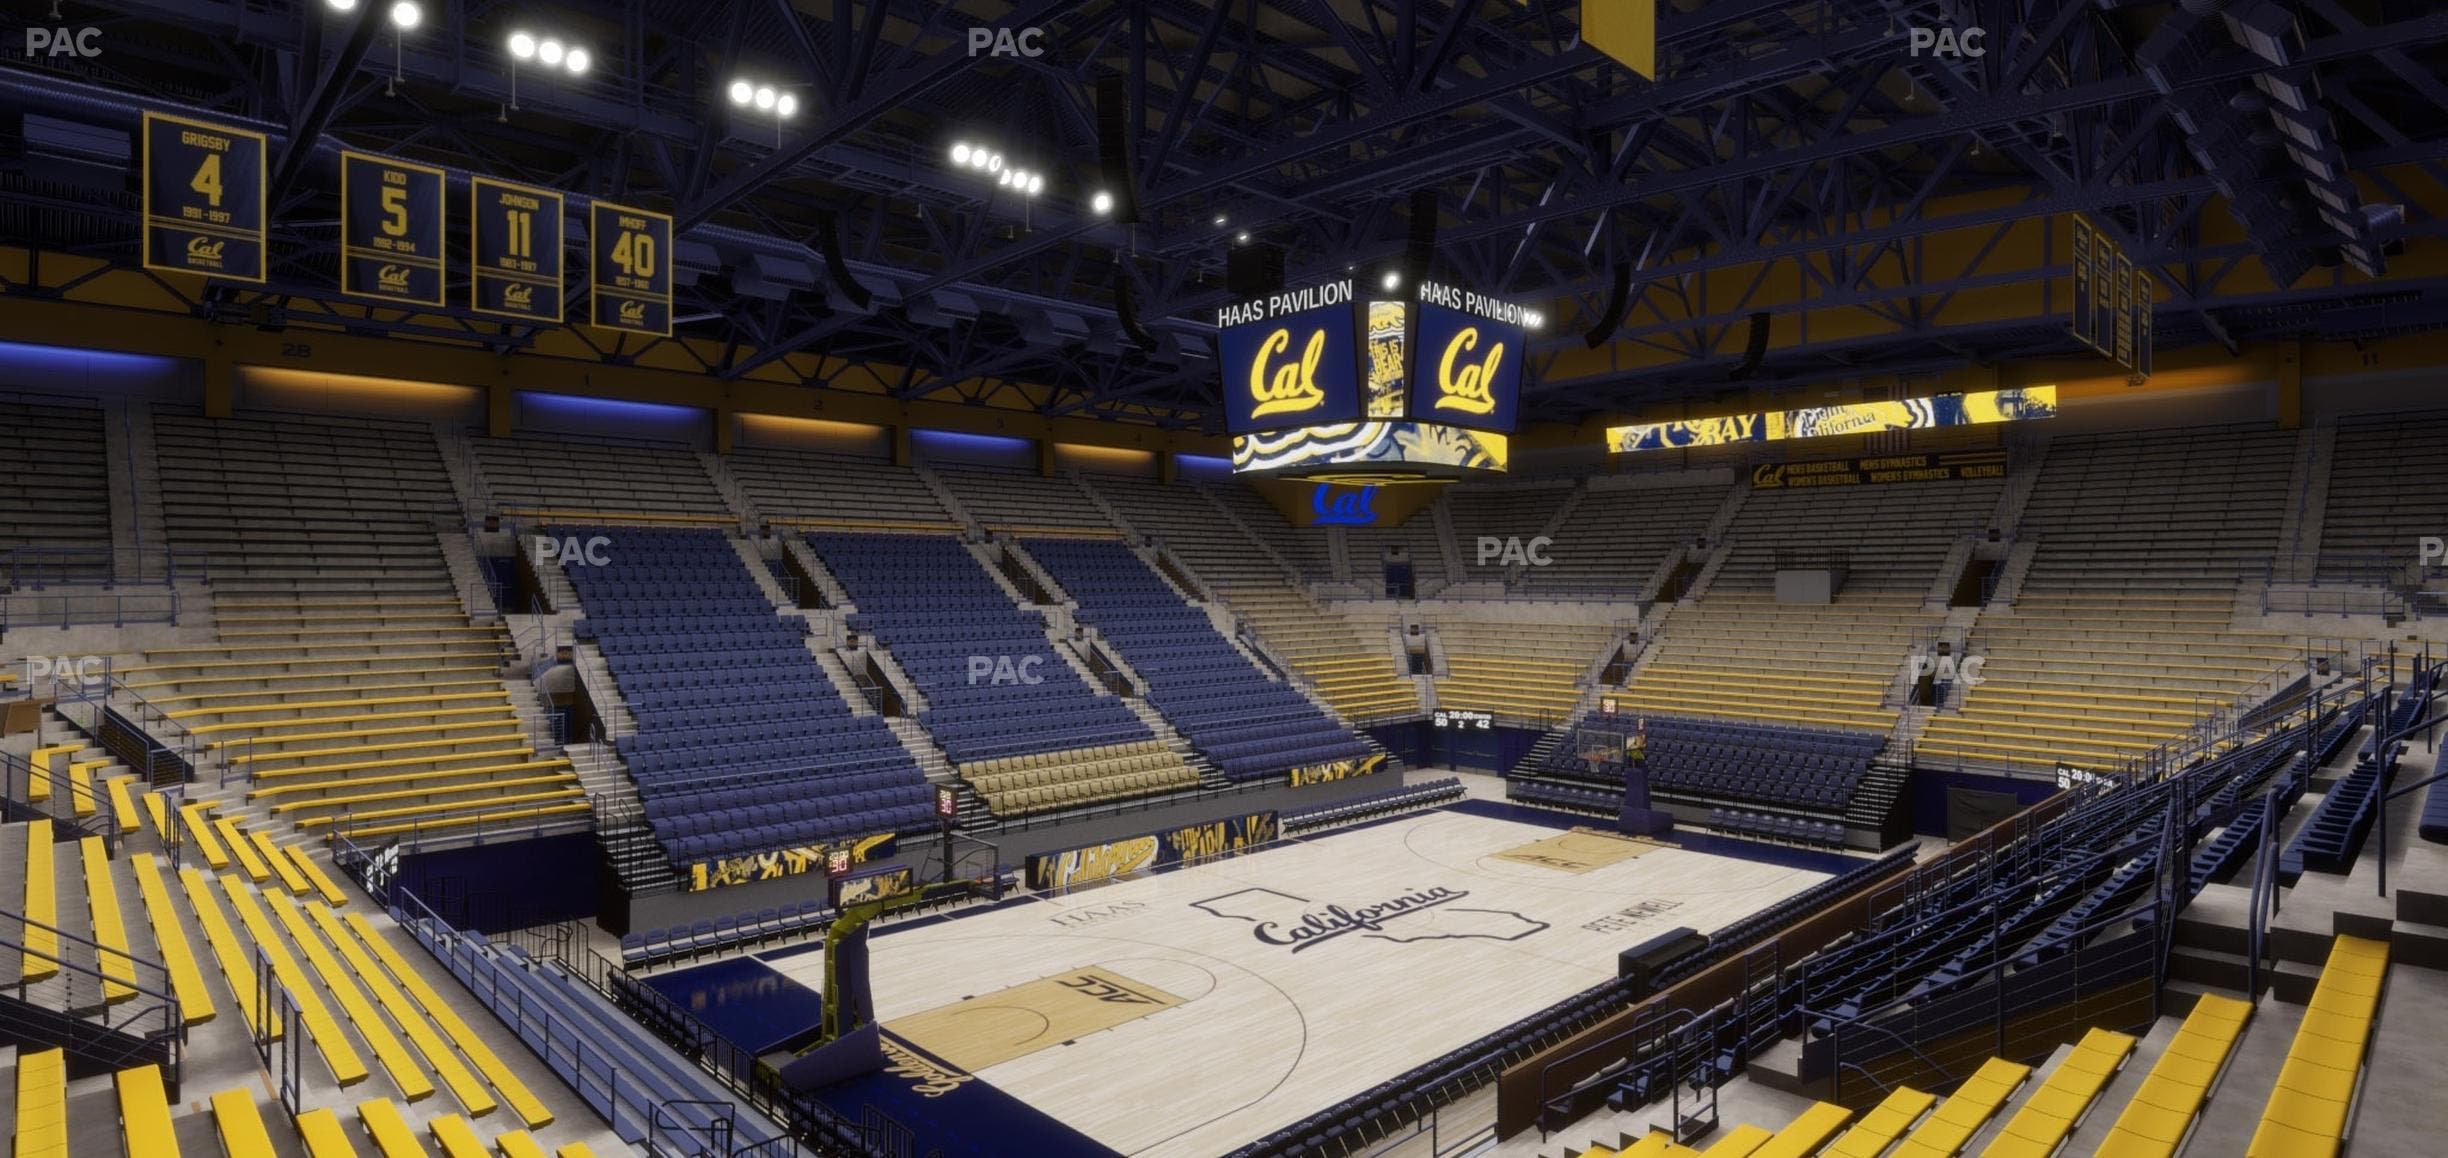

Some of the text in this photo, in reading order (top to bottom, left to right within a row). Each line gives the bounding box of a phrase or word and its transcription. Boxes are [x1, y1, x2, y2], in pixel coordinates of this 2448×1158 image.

[182, 131, 230, 151] GRIGSBY
[190, 154, 222, 206] 4
[382, 186, 407, 237] 5
[499, 193, 539, 210] JOHNSON
[507, 210, 530, 257] 11
[187, 236, 224, 260] Cal
[611, 231, 654, 278] 40
[379, 265, 410, 286] Cal
[504, 283, 532, 303] Cal
[1218, 279, 1353, 328] HAAS PAVILION
[1421, 281, 1527, 327] HAAS PAVILION
[620, 300, 646, 318] Cal
[1250, 328, 1325, 419] Cal
[1435, 327, 1504, 414] Cal
[1753, 464, 1785, 487] Cal
[1807, 460, 1849, 472] BASKETBALL
[1311, 483, 1379, 525] Cal
[1435, 718, 1490, 729] 50 2 42
[1449, 711, 1473, 719] 20:00
[2057, 776, 2071, 789] 50
[1050, 901, 1145, 927] HAAS
[1253, 886, 1469, 954] California
[1581, 916, 1637, 934] PETE
[1054, 974, 1153, 1005] ACC
